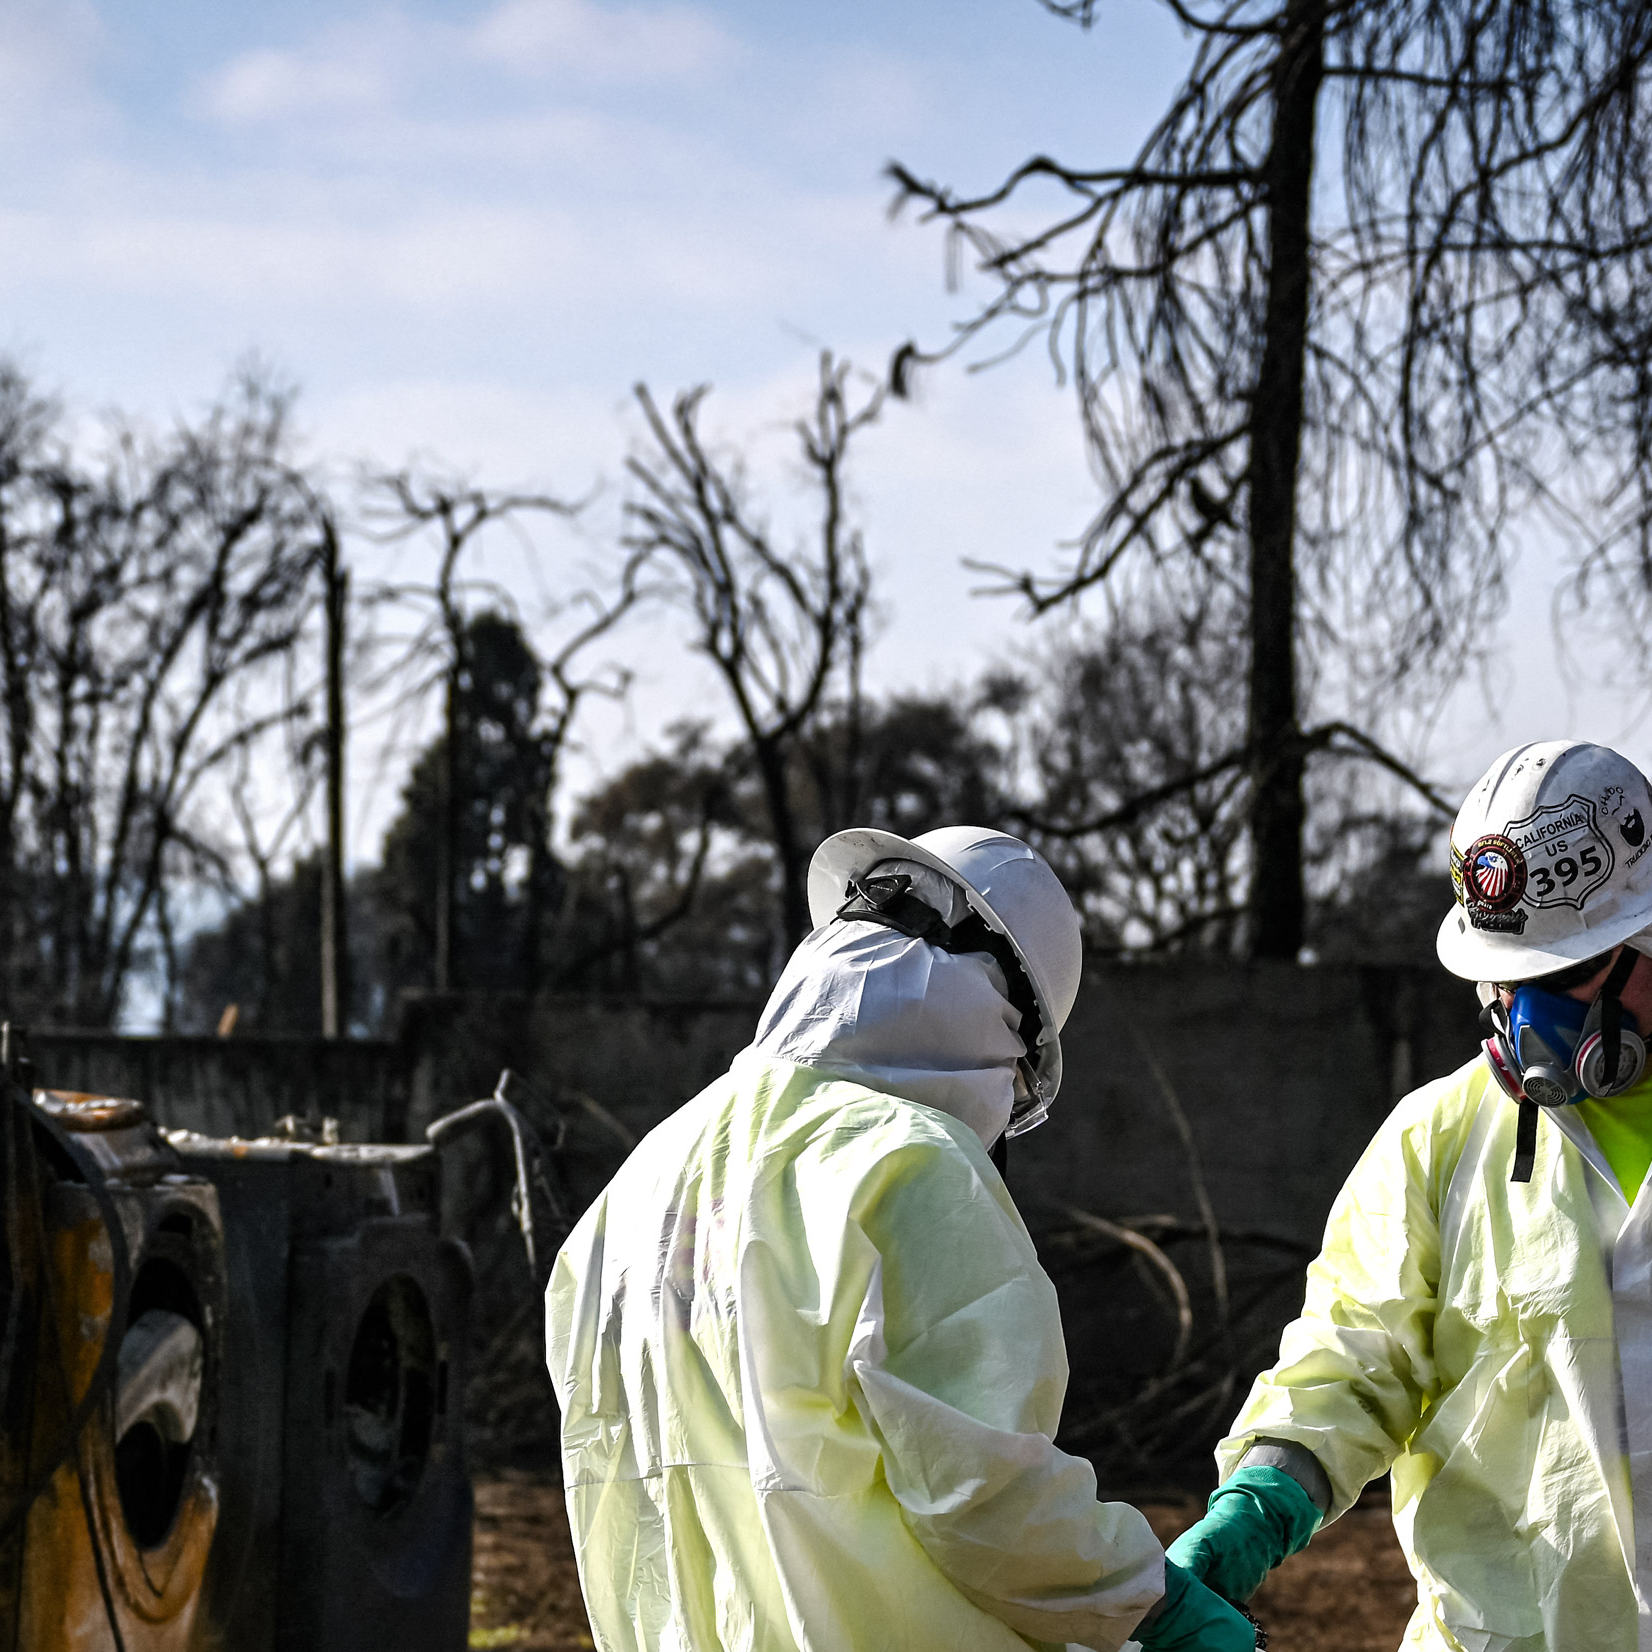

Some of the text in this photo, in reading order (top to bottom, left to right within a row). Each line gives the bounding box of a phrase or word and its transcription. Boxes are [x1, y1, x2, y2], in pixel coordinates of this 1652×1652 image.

[1515, 814, 1584, 849] CALIFORNIA
[1545, 840, 1568, 857] US
[1529, 846, 1602, 897] 395
